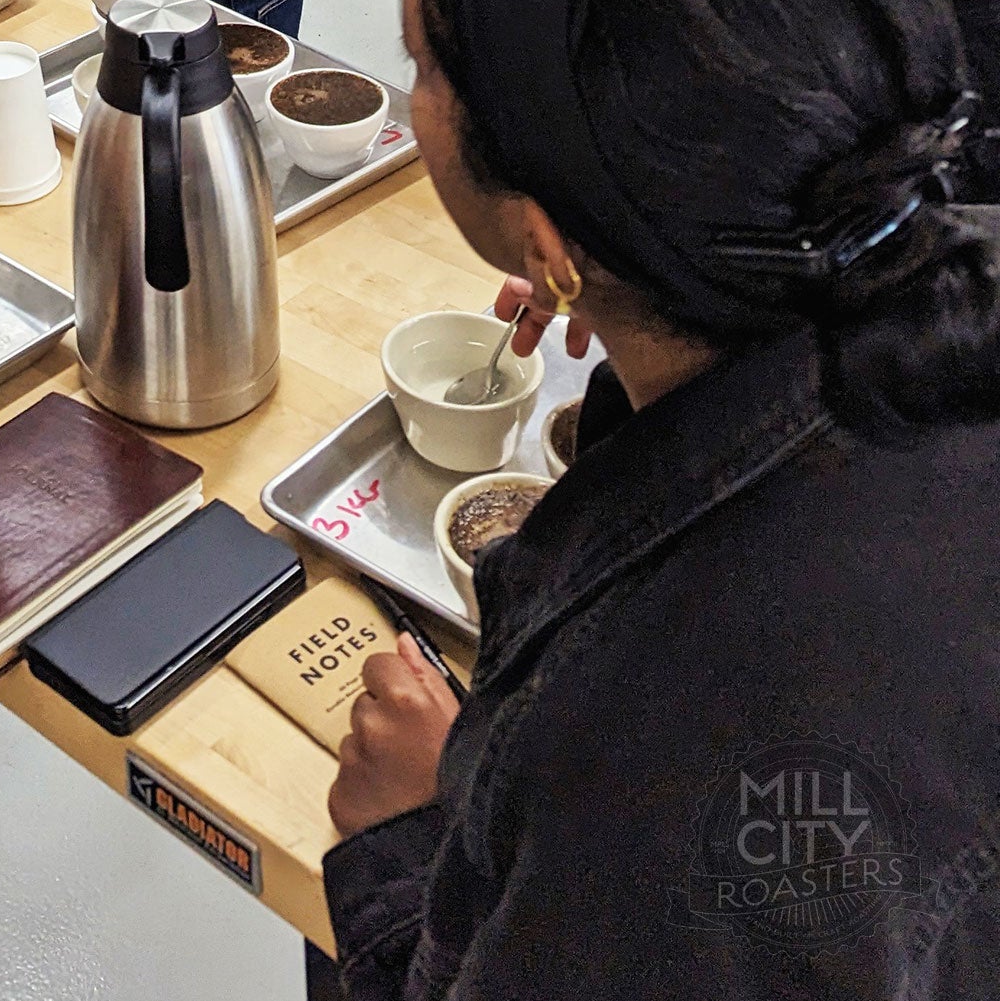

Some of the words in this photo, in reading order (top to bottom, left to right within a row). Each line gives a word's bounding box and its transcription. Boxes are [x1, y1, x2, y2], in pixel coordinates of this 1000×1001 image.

[288, 617, 351, 664] FIELD
[300, 627, 377, 686] NOTES
[155, 786, 251, 873] GLADIATOR
